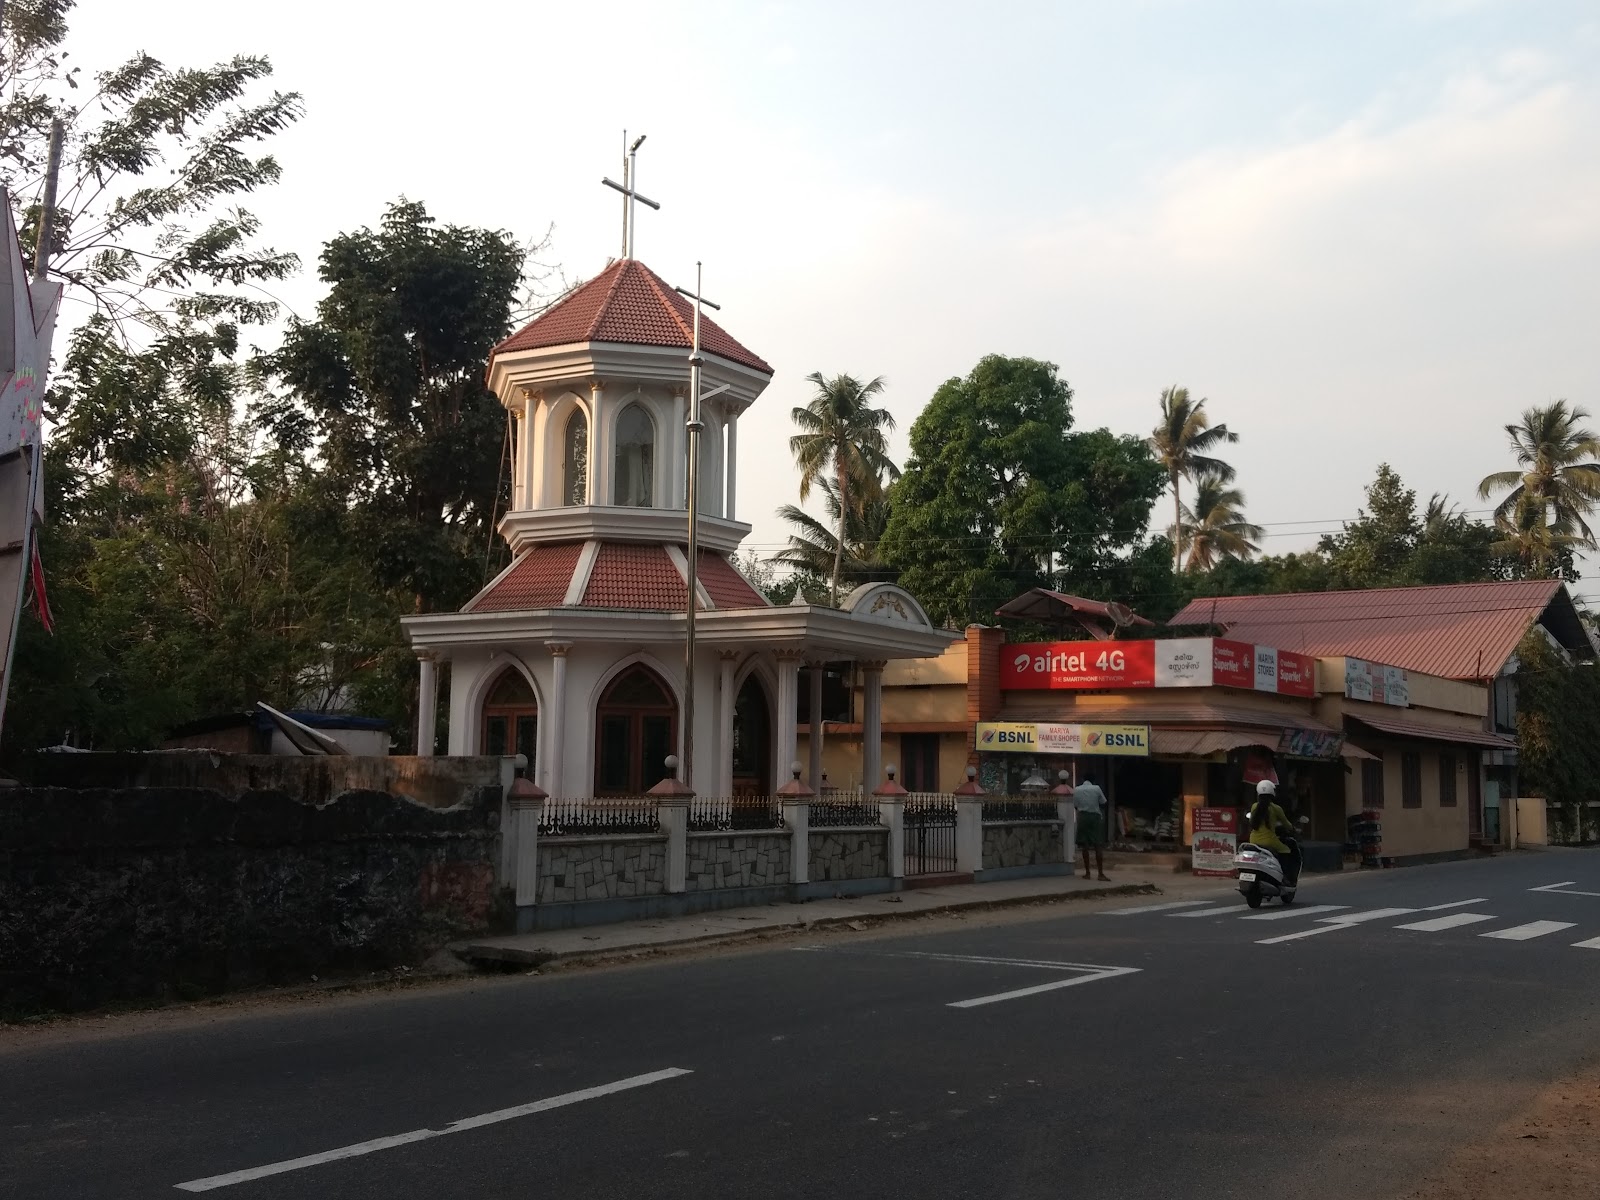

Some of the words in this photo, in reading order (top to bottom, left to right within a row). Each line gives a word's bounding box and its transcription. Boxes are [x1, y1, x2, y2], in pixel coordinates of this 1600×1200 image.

[1033, 650, 1087, 673] airtel
[1095, 650, 1125, 671] 4G
[1214, 657, 1239, 673] SuperNet
[1257, 653, 1275, 665] MARIYA
[1257, 664, 1275, 677] STORES
[1279, 669, 1302, 683] SuperNet
[1063, 675, 1099, 683] SMARTPHONE
[998, 731, 1035, 744] BSNL
[1105, 733, 1145, 747] BSNL
